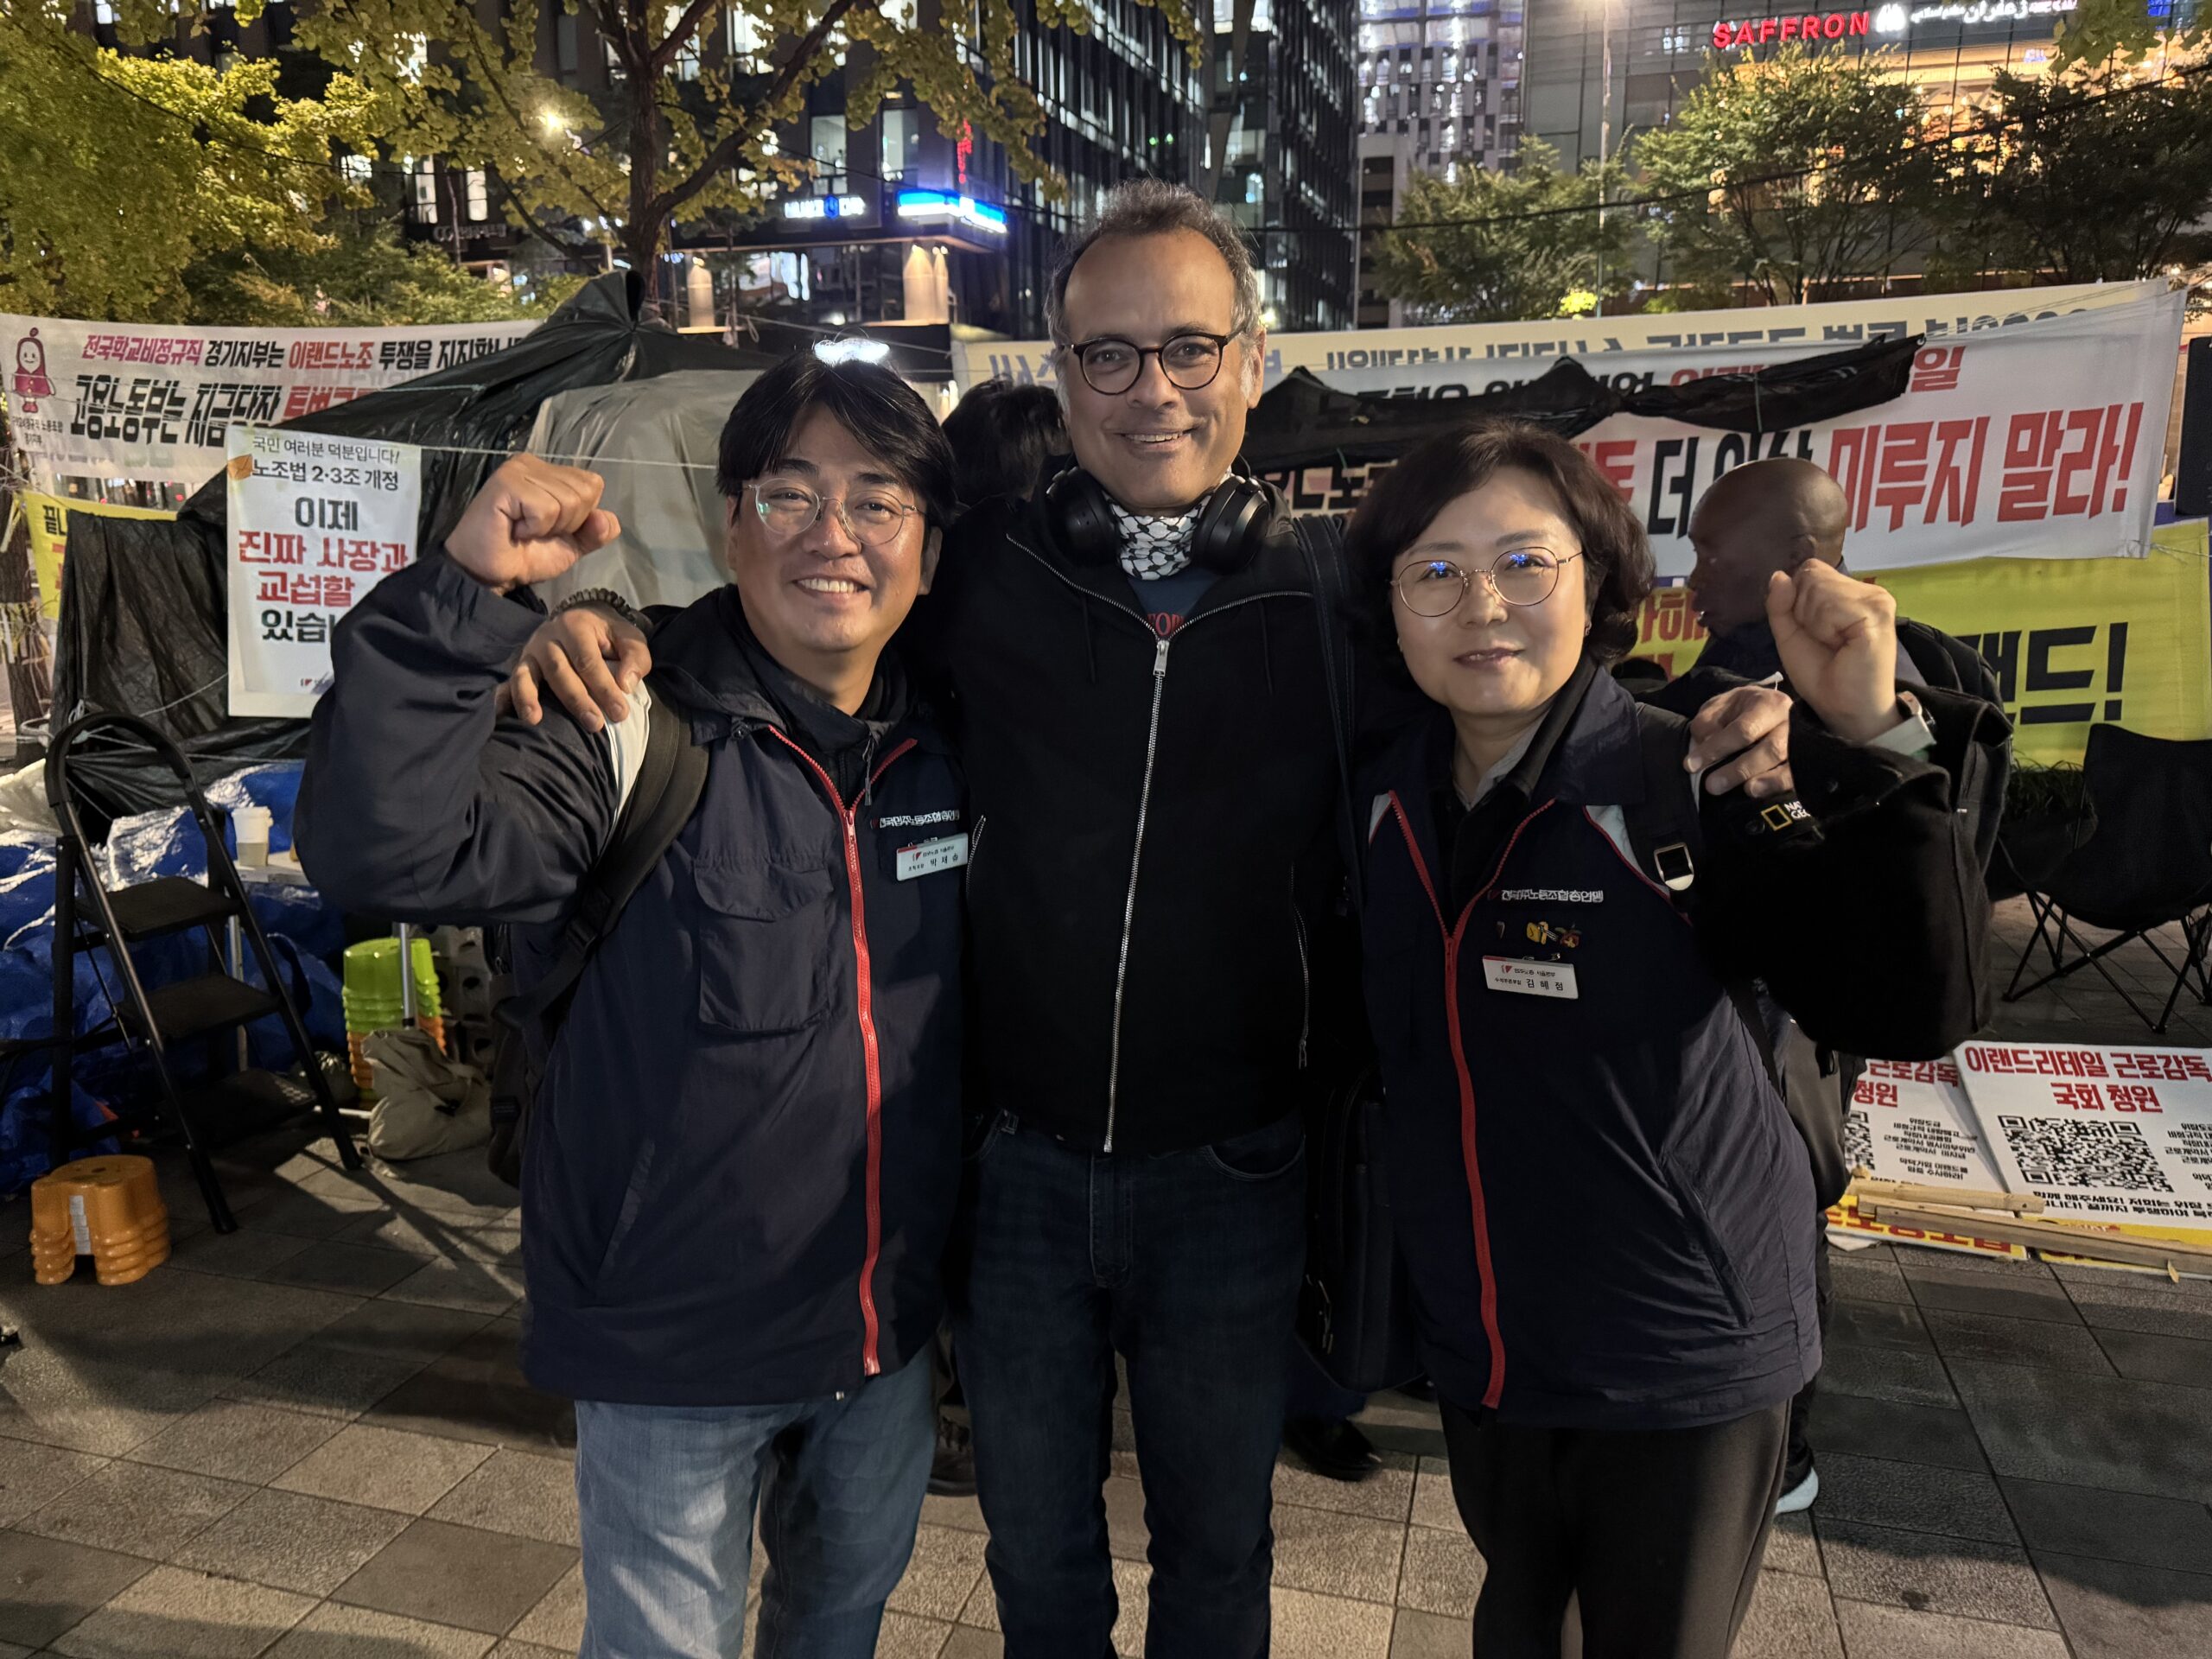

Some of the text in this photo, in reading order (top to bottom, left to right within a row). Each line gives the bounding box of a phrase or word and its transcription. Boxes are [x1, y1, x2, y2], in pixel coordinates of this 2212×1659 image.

[1713, 11, 1870, 49] SAFFRON
[82, 334, 205, 366] 전국학교비정규직
[204, 340, 284, 369] 경기지부는
[289, 340, 375, 370] 이랜드노조
[378, 340, 433, 371] 투쟁을
[71, 374, 187, 445] 고용노동부는
[252, 435, 401, 464] 국민 여러분 덕분입니다!
[251, 459, 399, 492] 노조법 2·3조 개정
[1647, 435, 1700, 540] 더
[1827, 416, 1992, 534] 미루지
[1996, 401, 2145, 523] 말라!
[295, 496, 359, 532] 이제
[238, 530, 409, 574] 진짜 사장과
[256, 570, 355, 608] 교섭할
[1869, 1059, 1959, 1088] 근로감독
[1964, 1046, 2212, 1083] 이랜드리테일 근로감독
[1853, 1080, 1898, 1108] 청원
[2050, 1082, 2164, 1114] 국회 청원
